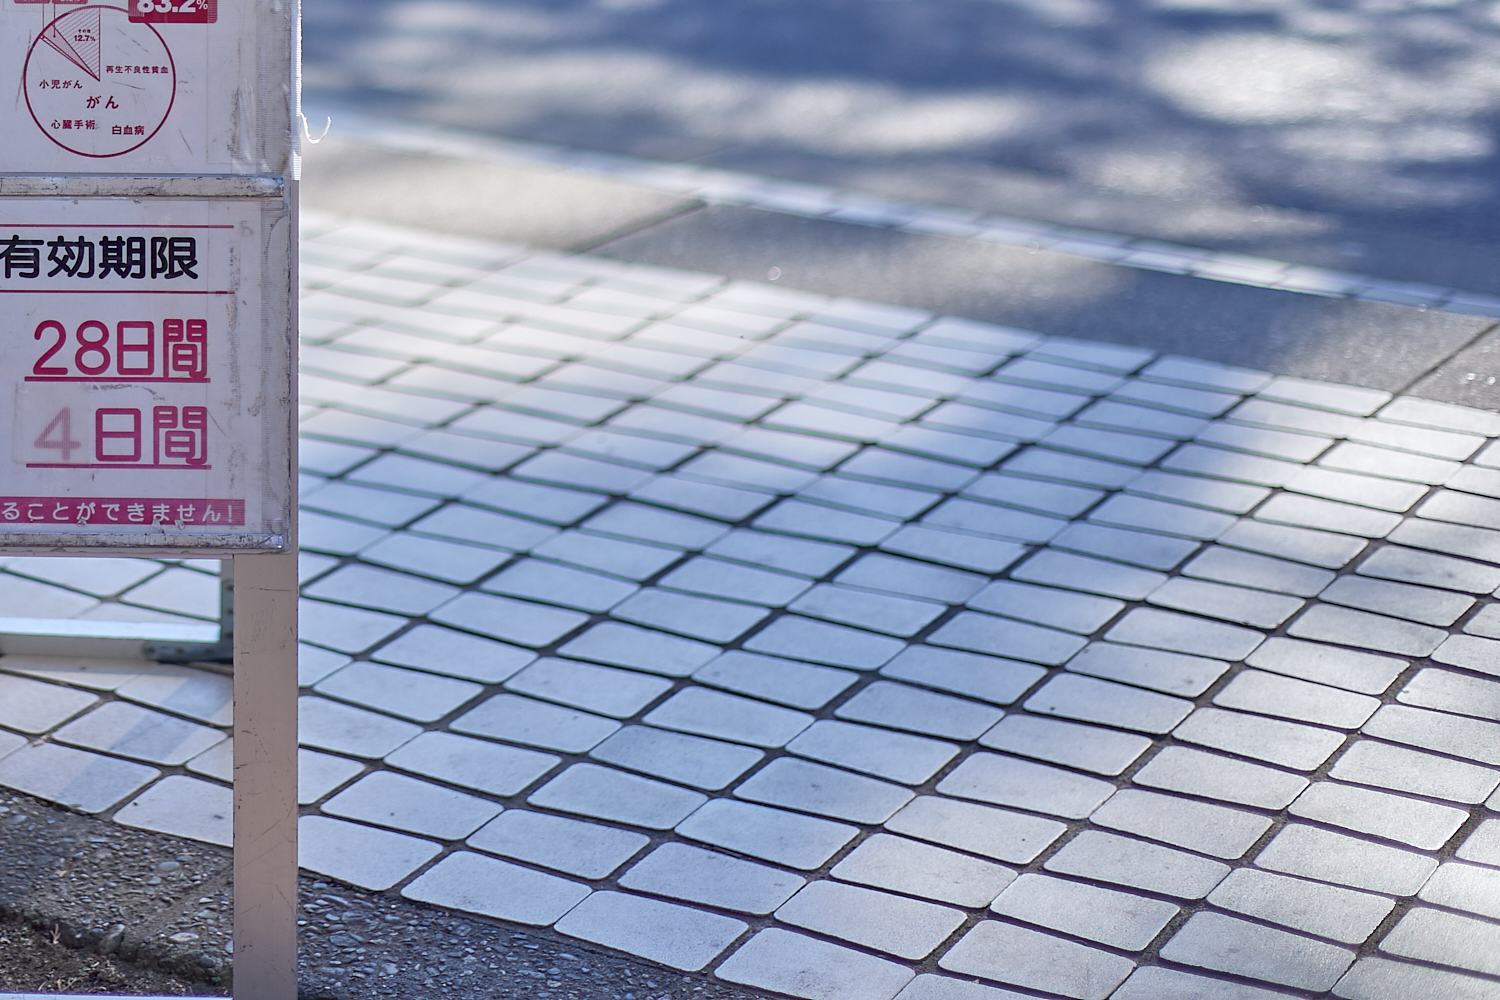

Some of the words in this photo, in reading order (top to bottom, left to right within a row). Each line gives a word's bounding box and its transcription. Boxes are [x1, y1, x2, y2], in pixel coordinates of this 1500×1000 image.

[105, 66, 169, 75] 再生不良性貧血
[39, 79, 83, 89] 小児がん
[86, 95, 120, 109] がん
[51, 119, 96, 130] 心臓手術
[112, 125, 145, 136] 白血病
[32, 318, 209, 379] 28日間
[33, 405, 208, 466] 4日間
